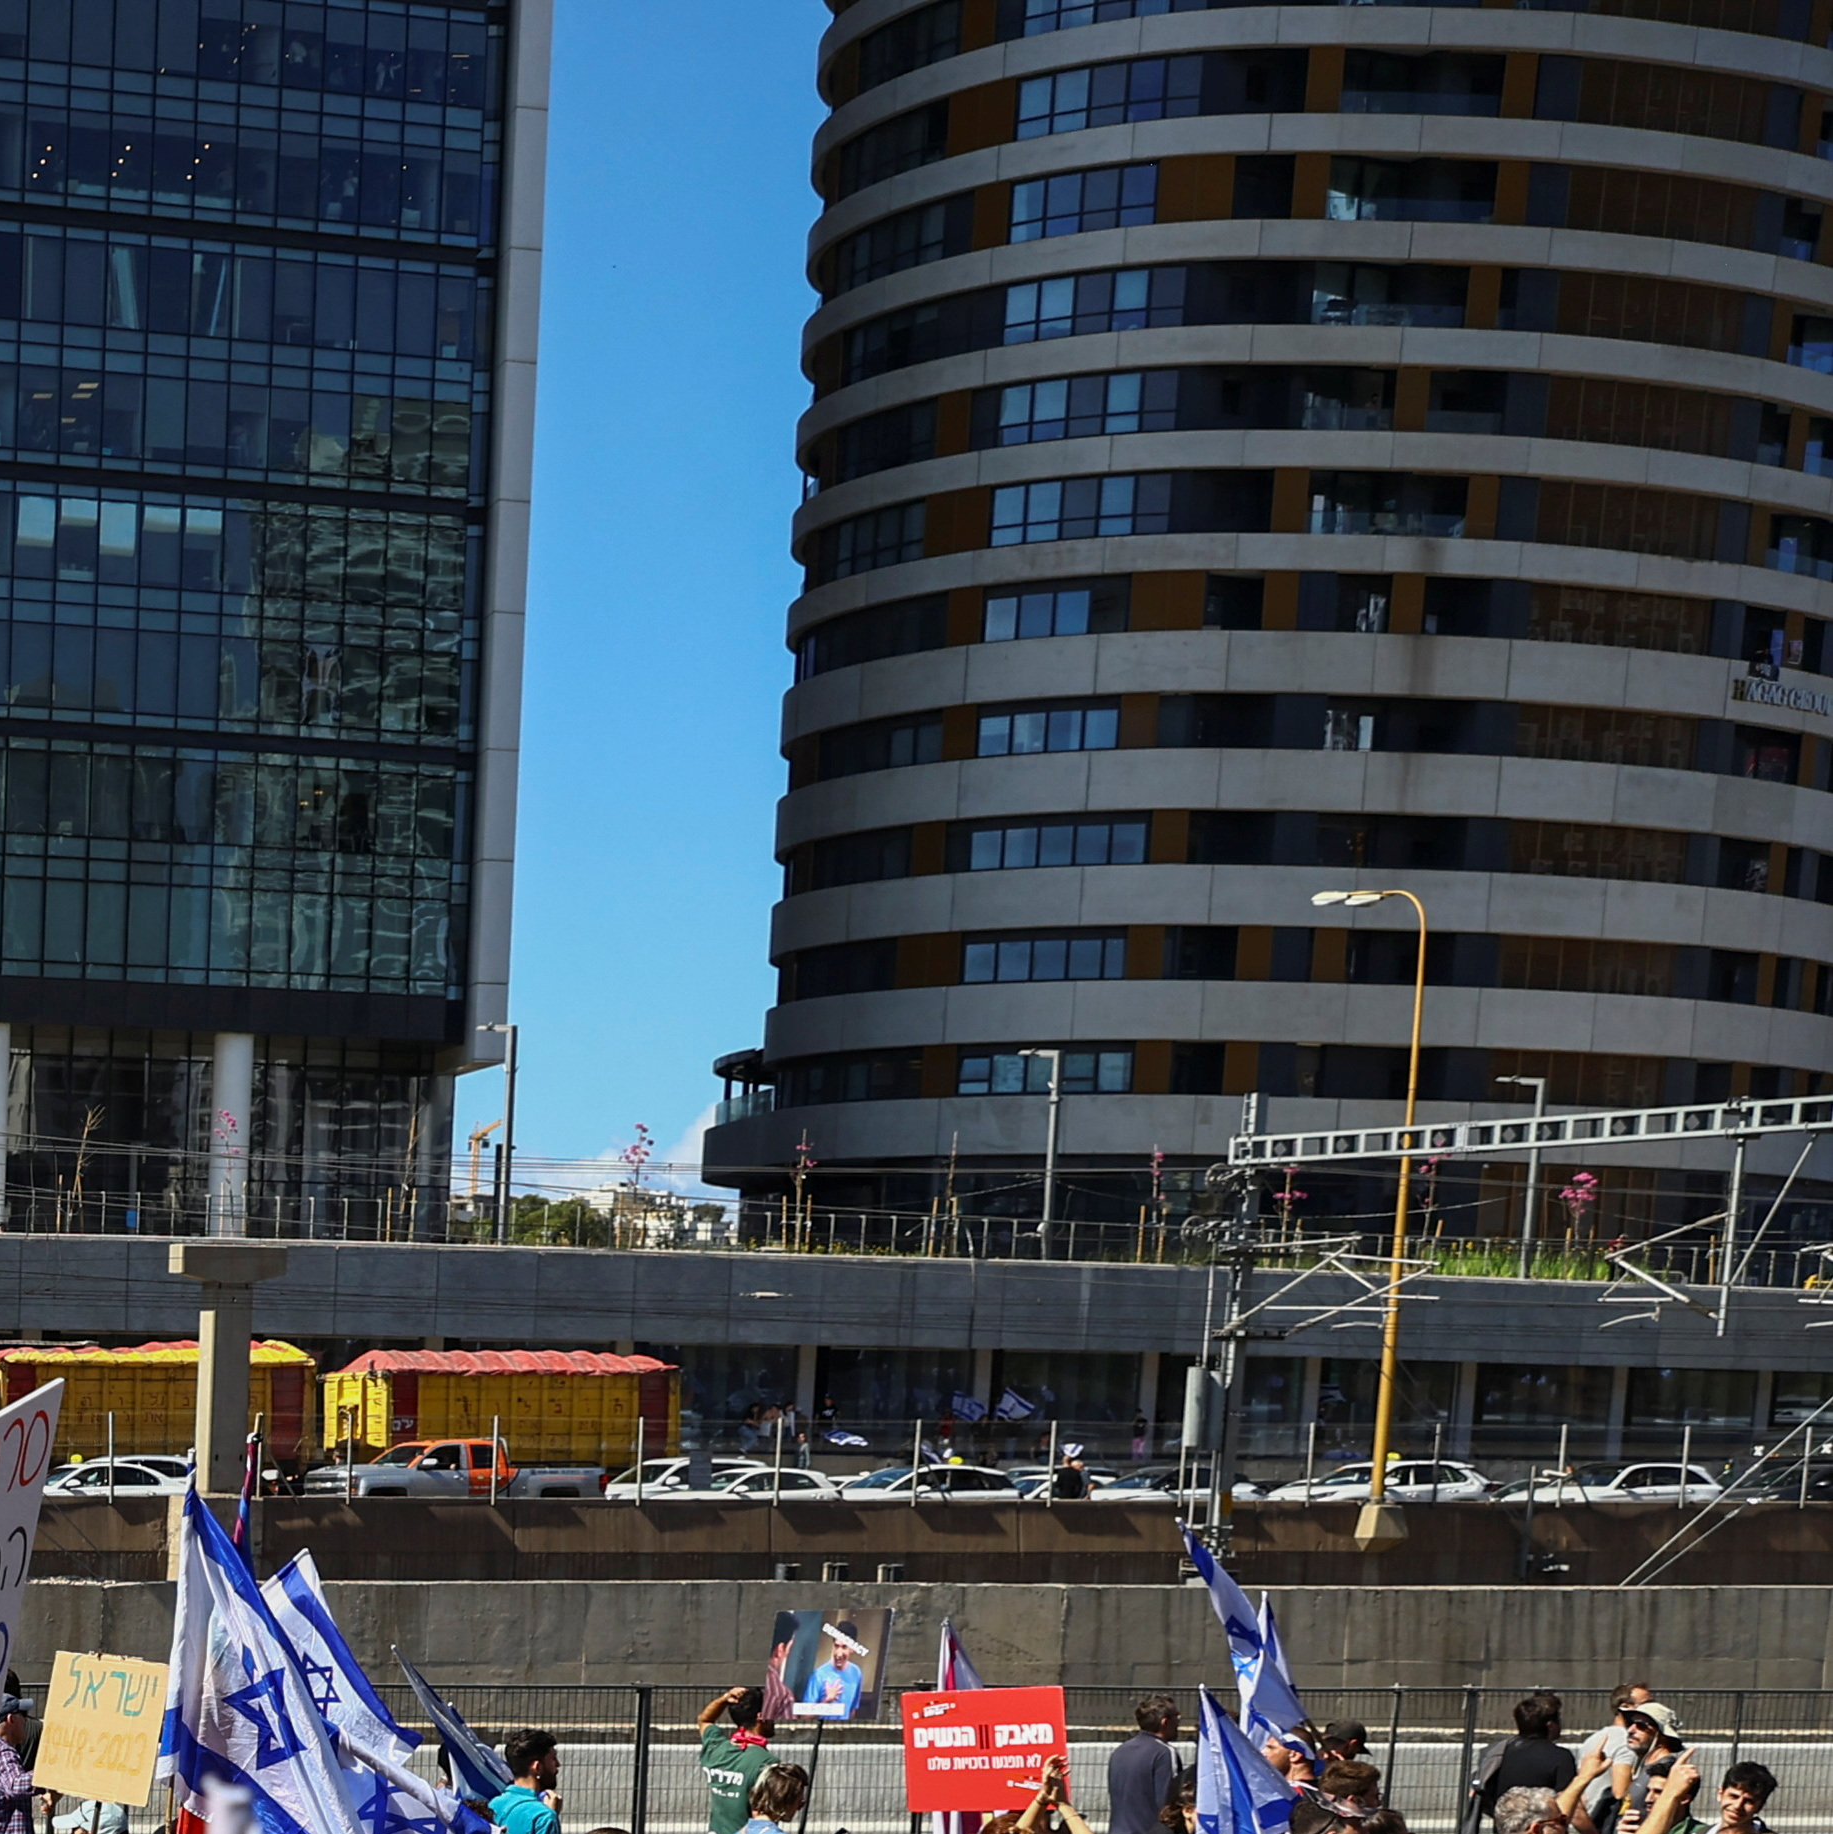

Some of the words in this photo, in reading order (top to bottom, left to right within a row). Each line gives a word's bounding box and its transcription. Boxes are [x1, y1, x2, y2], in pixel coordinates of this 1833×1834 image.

[1789, 688, 1833, 716] GROU
[822, 1622, 870, 1657] DEMOCRACY
[63, 1655, 159, 1717] ישראל
[913, 1726, 976, 1748] הנשים
[994, 1723, 1054, 1748] מאבק
[42, 1722, 148, 1777] 1948-2023
[992, 1755, 1025, 1769] תפגעו
[1026, 1752, 1042, 1768] לא
[927, 1756, 951, 1770] שלנו
